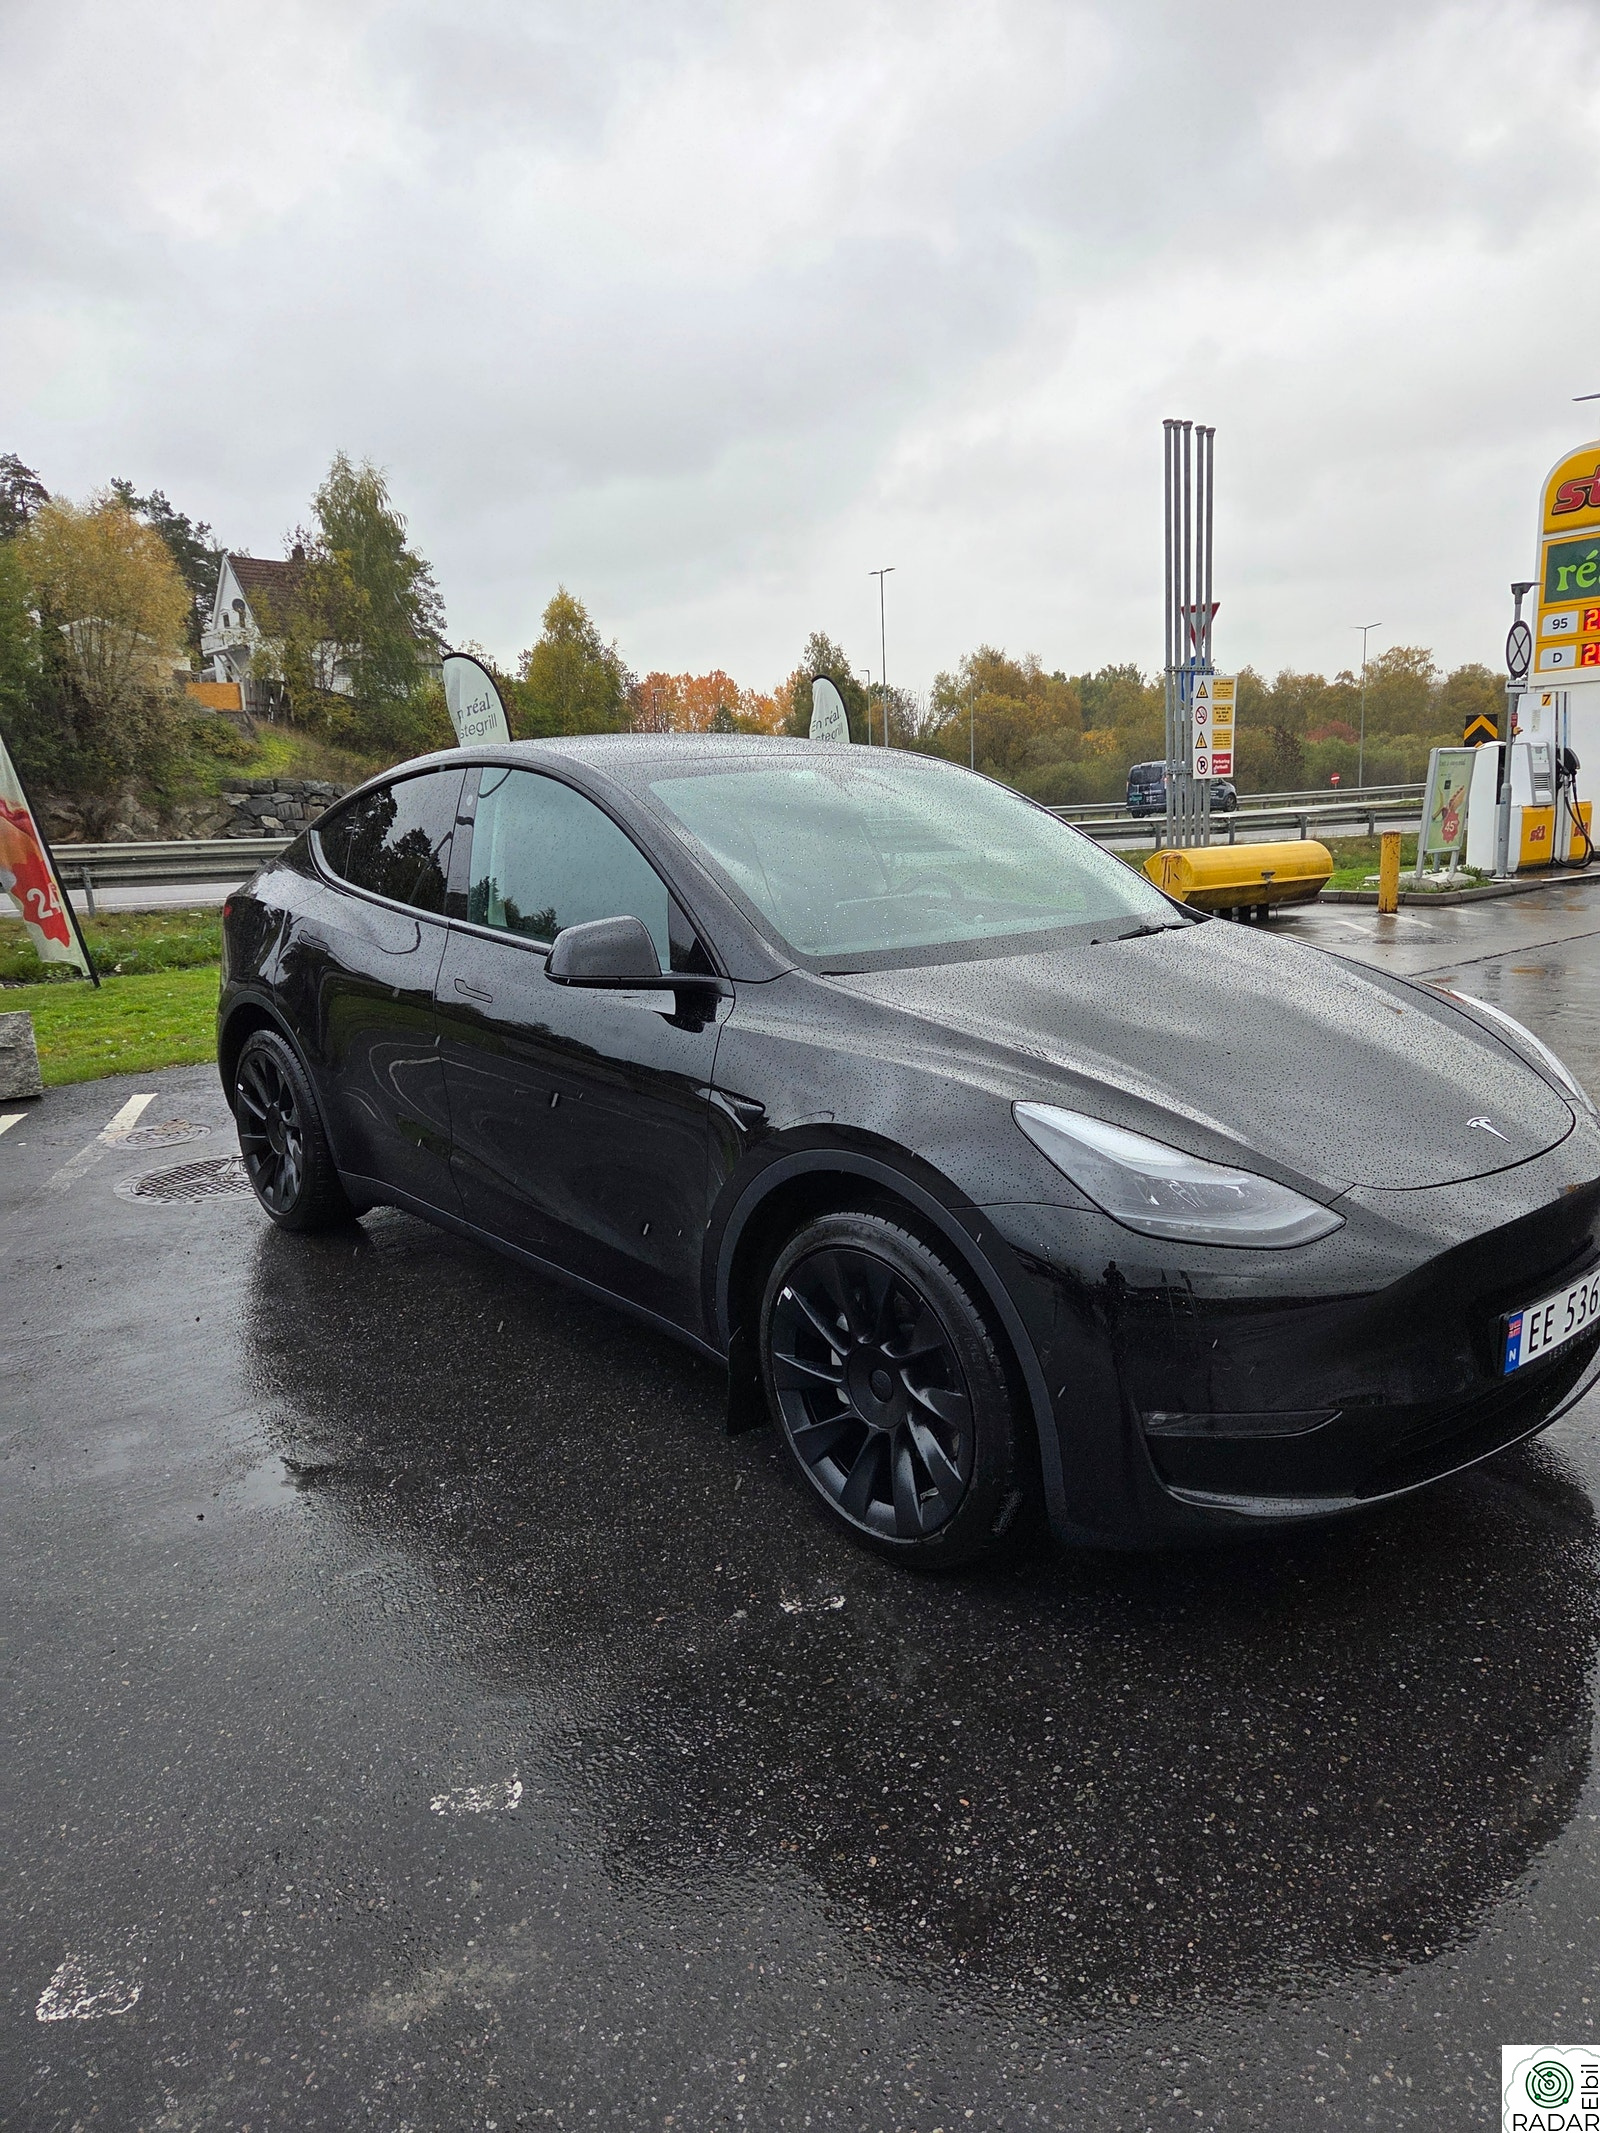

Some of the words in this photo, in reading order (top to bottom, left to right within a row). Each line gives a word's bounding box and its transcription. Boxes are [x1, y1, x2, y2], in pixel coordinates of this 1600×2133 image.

[1556, 549, 1600, 591] ré
[1552, 618, 1568, 630] 95
[1586, 609, 1600, 631] 2
[1552, 653, 1562, 663] D
[1584, 644, 1600, 665] 2
[1542, 694, 1551, 706] 7
[1528, 1303, 1555, 1354] EE
[1508, 1348, 1517, 1362] N
